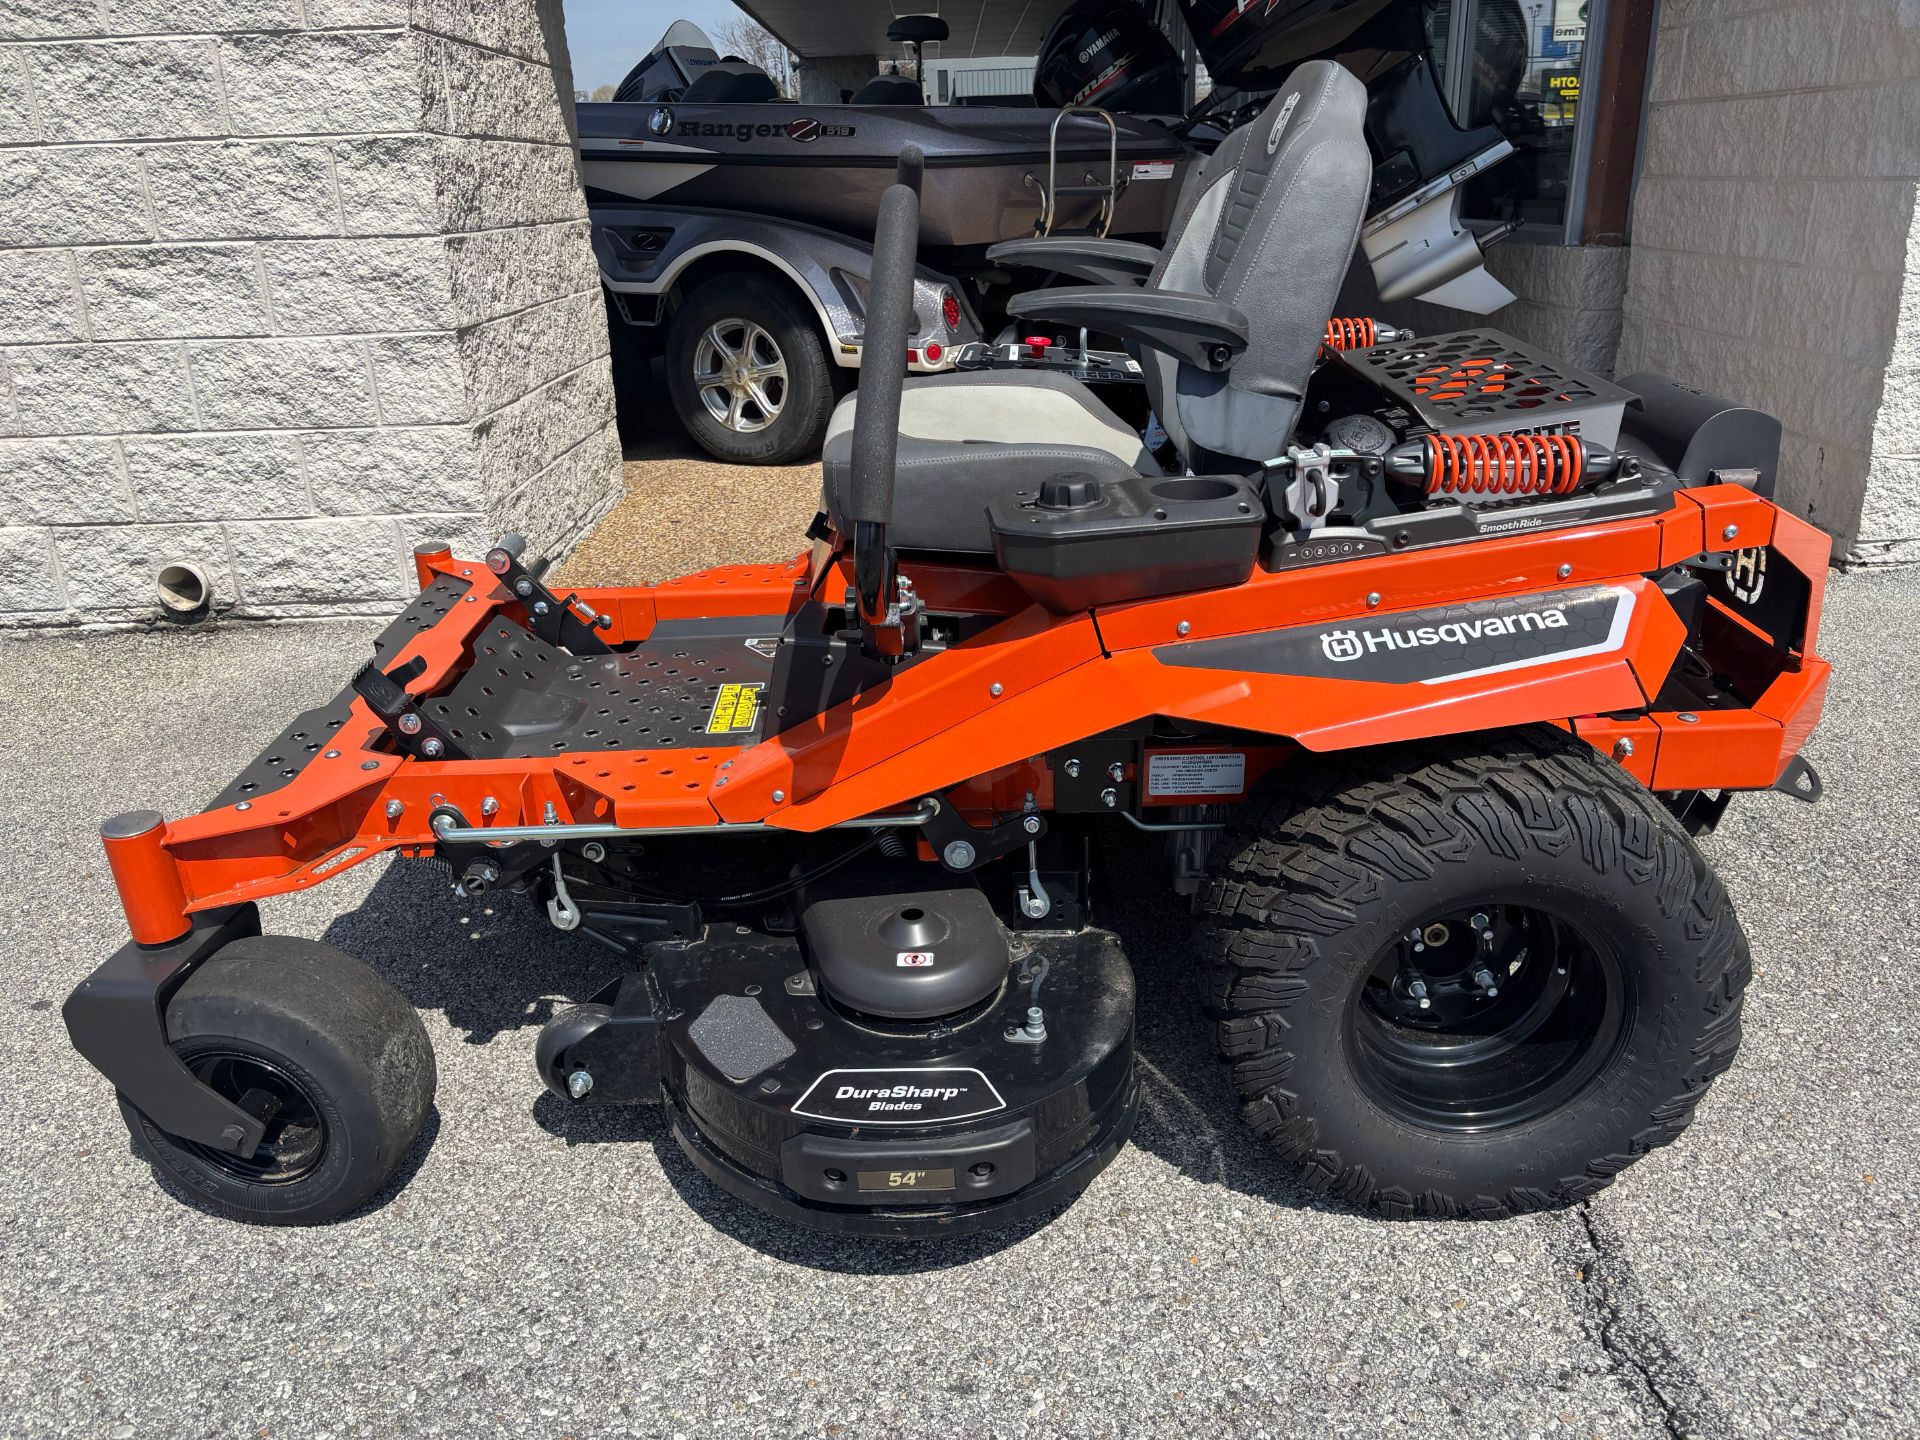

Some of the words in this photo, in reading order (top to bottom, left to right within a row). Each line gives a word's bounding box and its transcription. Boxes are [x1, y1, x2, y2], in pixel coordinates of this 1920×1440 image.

[1086, 28, 1120, 56] YAMAHA
[677, 121, 788, 142] Ranger
[868, 1102, 922, 1111] Blades
